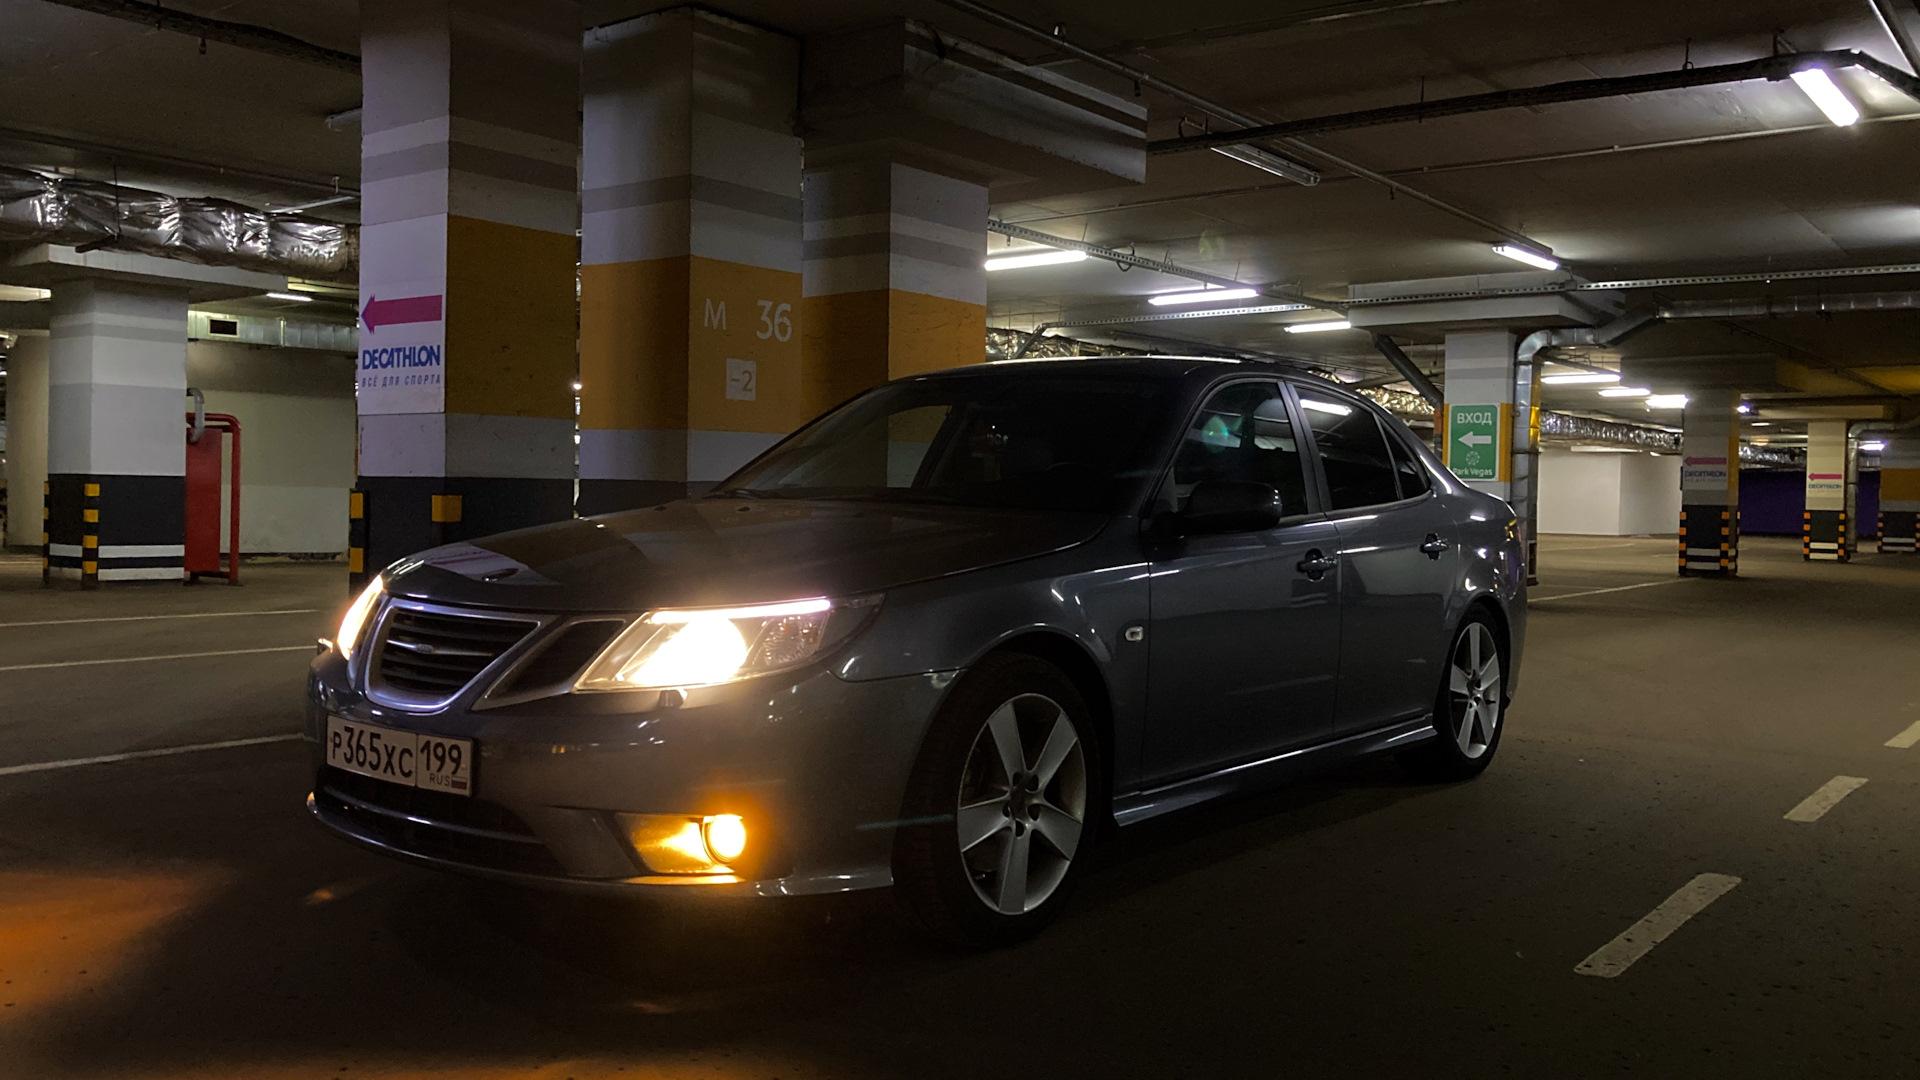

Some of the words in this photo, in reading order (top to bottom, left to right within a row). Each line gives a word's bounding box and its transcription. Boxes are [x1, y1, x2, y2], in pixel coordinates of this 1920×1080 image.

[756, 300, 792, 342] 36
[362, 345, 441, 370] DECATHLON
[382, 376, 400, 388] ДЛЯ
[404, 374, 441, 386] СПОРТА
[731, 370, 753, 392] -2
[1457, 412, 1492, 426] ВХОД
[1470, 467, 1493, 477] Vegas
[420, 740, 462, 775] 199
[429, 774, 450, 787] RUS
